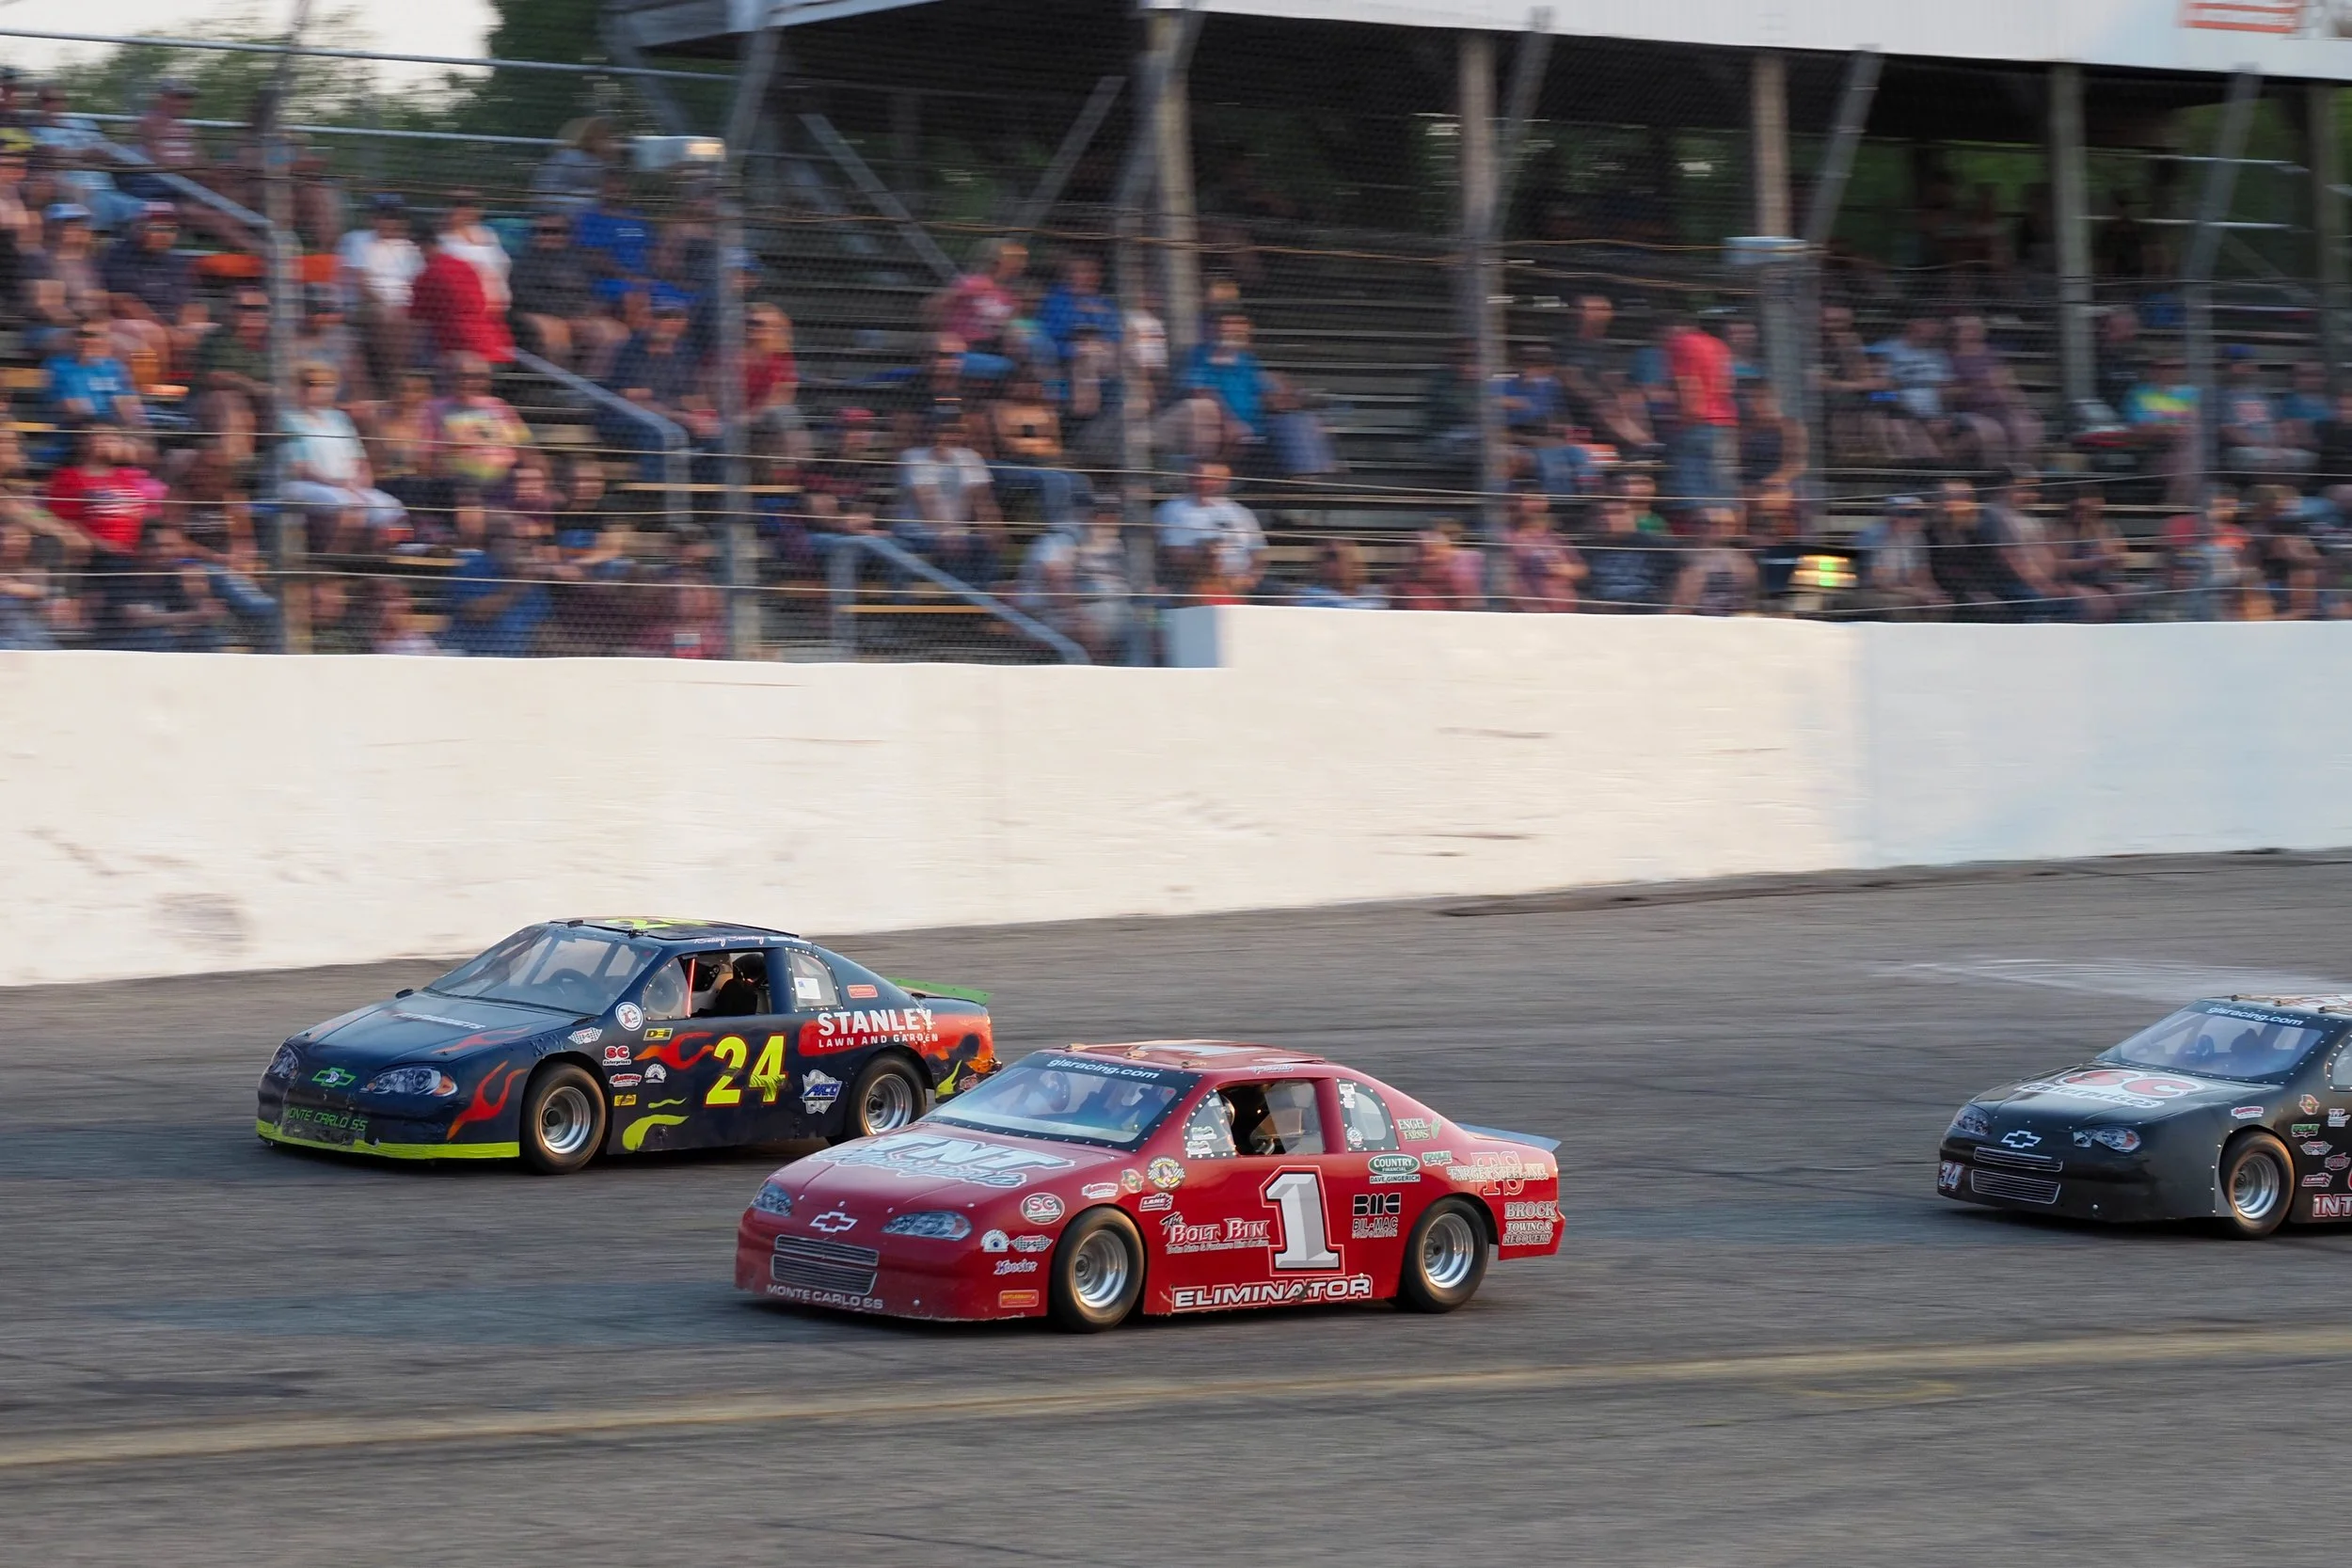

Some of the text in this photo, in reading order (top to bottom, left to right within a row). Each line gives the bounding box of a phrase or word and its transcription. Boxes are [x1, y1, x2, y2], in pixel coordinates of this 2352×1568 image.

[818, 1008, 932, 1037] STANLEY
[2206, 1006, 2304, 1026] glsracing.com
[818, 1032, 939, 1048] LAWN AND GARDEN
[605, 1047, 629, 1059] SC
[705, 1034, 787, 1106] 24
[1047, 1058, 1160, 1079] glsracing.com
[2062, 1069, 2198, 1098] SC
[313, 1112, 349, 1128] CARLO
[350, 1118, 368, 1132] SS
[1397, 1117, 1428, 1131] ENGEL
[1405, 1130, 1430, 1141] FARMS
[866, 1132, 1074, 1170] TNT
[1374, 1158, 1412, 1168] COUNTRY
[1370, 1174, 1385, 1182] DAVE
[1939, 1161, 1963, 1190] 34
[1027, 1196, 1057, 1212] SC
[1142, 1197, 1167, 1206] LANE
[1504, 1201, 1558, 1220] BROCK
[1263, 1168, 1343, 1273] 1
[1352, 1216, 1399, 1231] BIL-MAC
[1505, 1221, 1553, 1233] TOWING &
[1502, 1232, 1553, 1245] RECOVERY
[767, 1284, 810, 1300] MONTE
[812, 1291, 860, 1307] CARLO
[1174, 1275, 1372, 1310] ELIMINATOR
